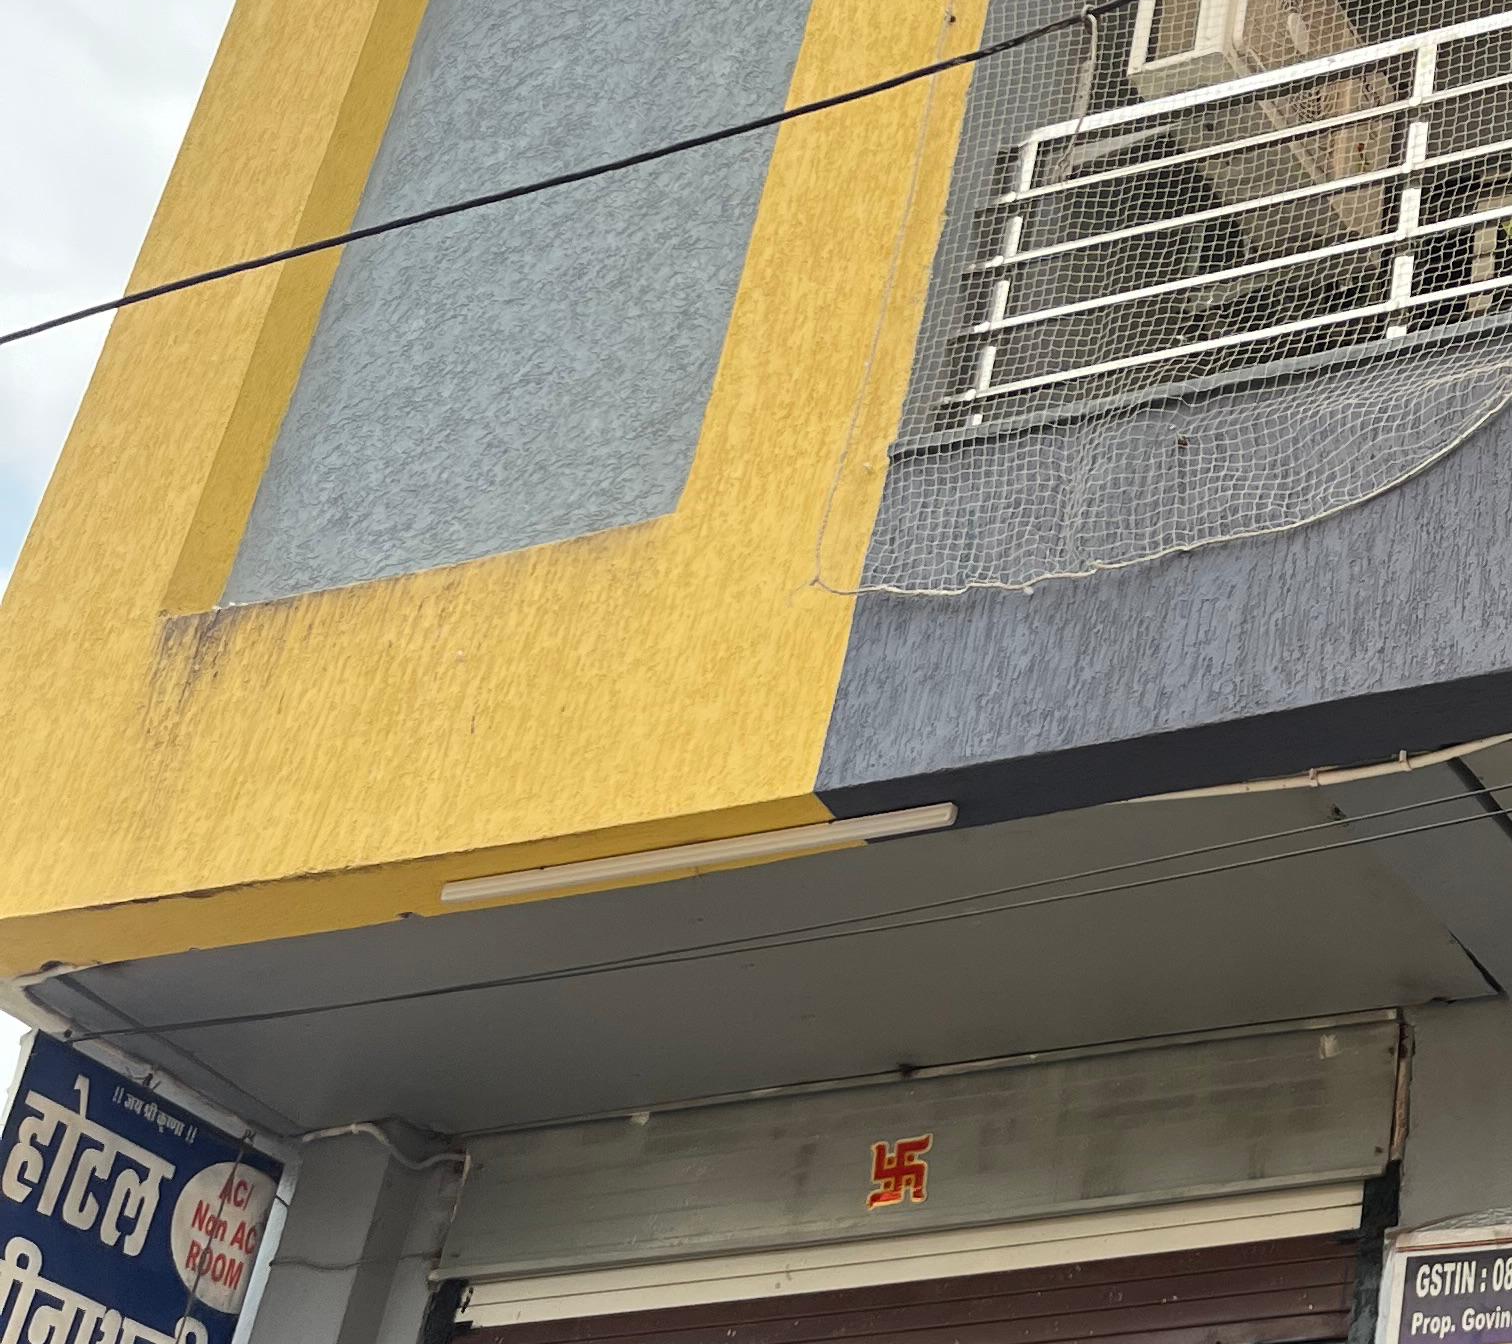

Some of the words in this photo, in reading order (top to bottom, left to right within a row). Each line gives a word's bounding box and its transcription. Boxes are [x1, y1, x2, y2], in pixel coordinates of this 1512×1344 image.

[1, 1074, 177, 1258] होटल
[192, 1199, 228, 1242] Non
[230, 1221, 257, 1255] AC
[186, 1239, 245, 1290] ROOM
[1416, 1259, 1477, 1298] GSTIN
[1411, 1310, 1456, 1336] Prop.
